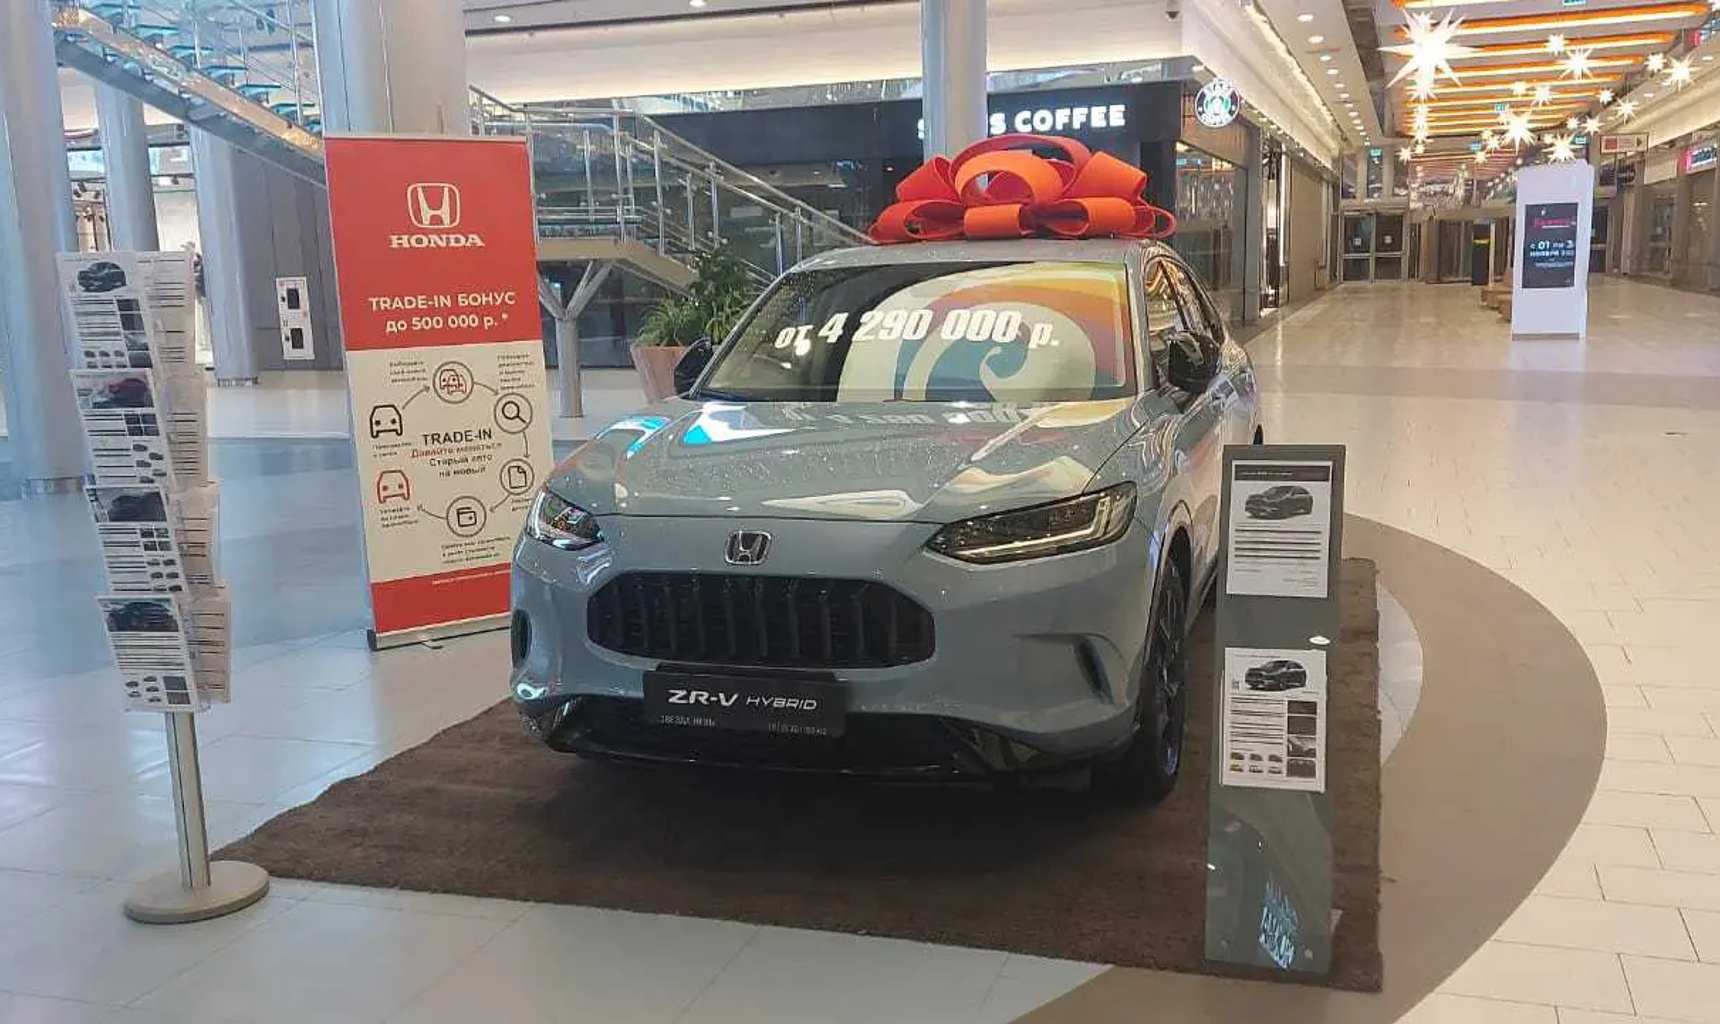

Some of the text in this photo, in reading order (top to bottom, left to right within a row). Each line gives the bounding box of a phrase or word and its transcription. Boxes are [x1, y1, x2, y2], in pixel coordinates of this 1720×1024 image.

[1015, 104, 1126, 133] COFFEE
[389, 234, 485, 249] HONDA
[1538, 240, 1550, 250] 01
[368, 291, 516, 311] TRADE-IN БОНУС
[385, 314, 498, 334] до 500 000 р.
[774, 308, 1060, 349] от 4 290 000 р.
[421, 428, 493, 446] TRADE-IN
[429, 455, 469, 467] Старый
[666, 689, 818, 711] ZR-V HYBRID
